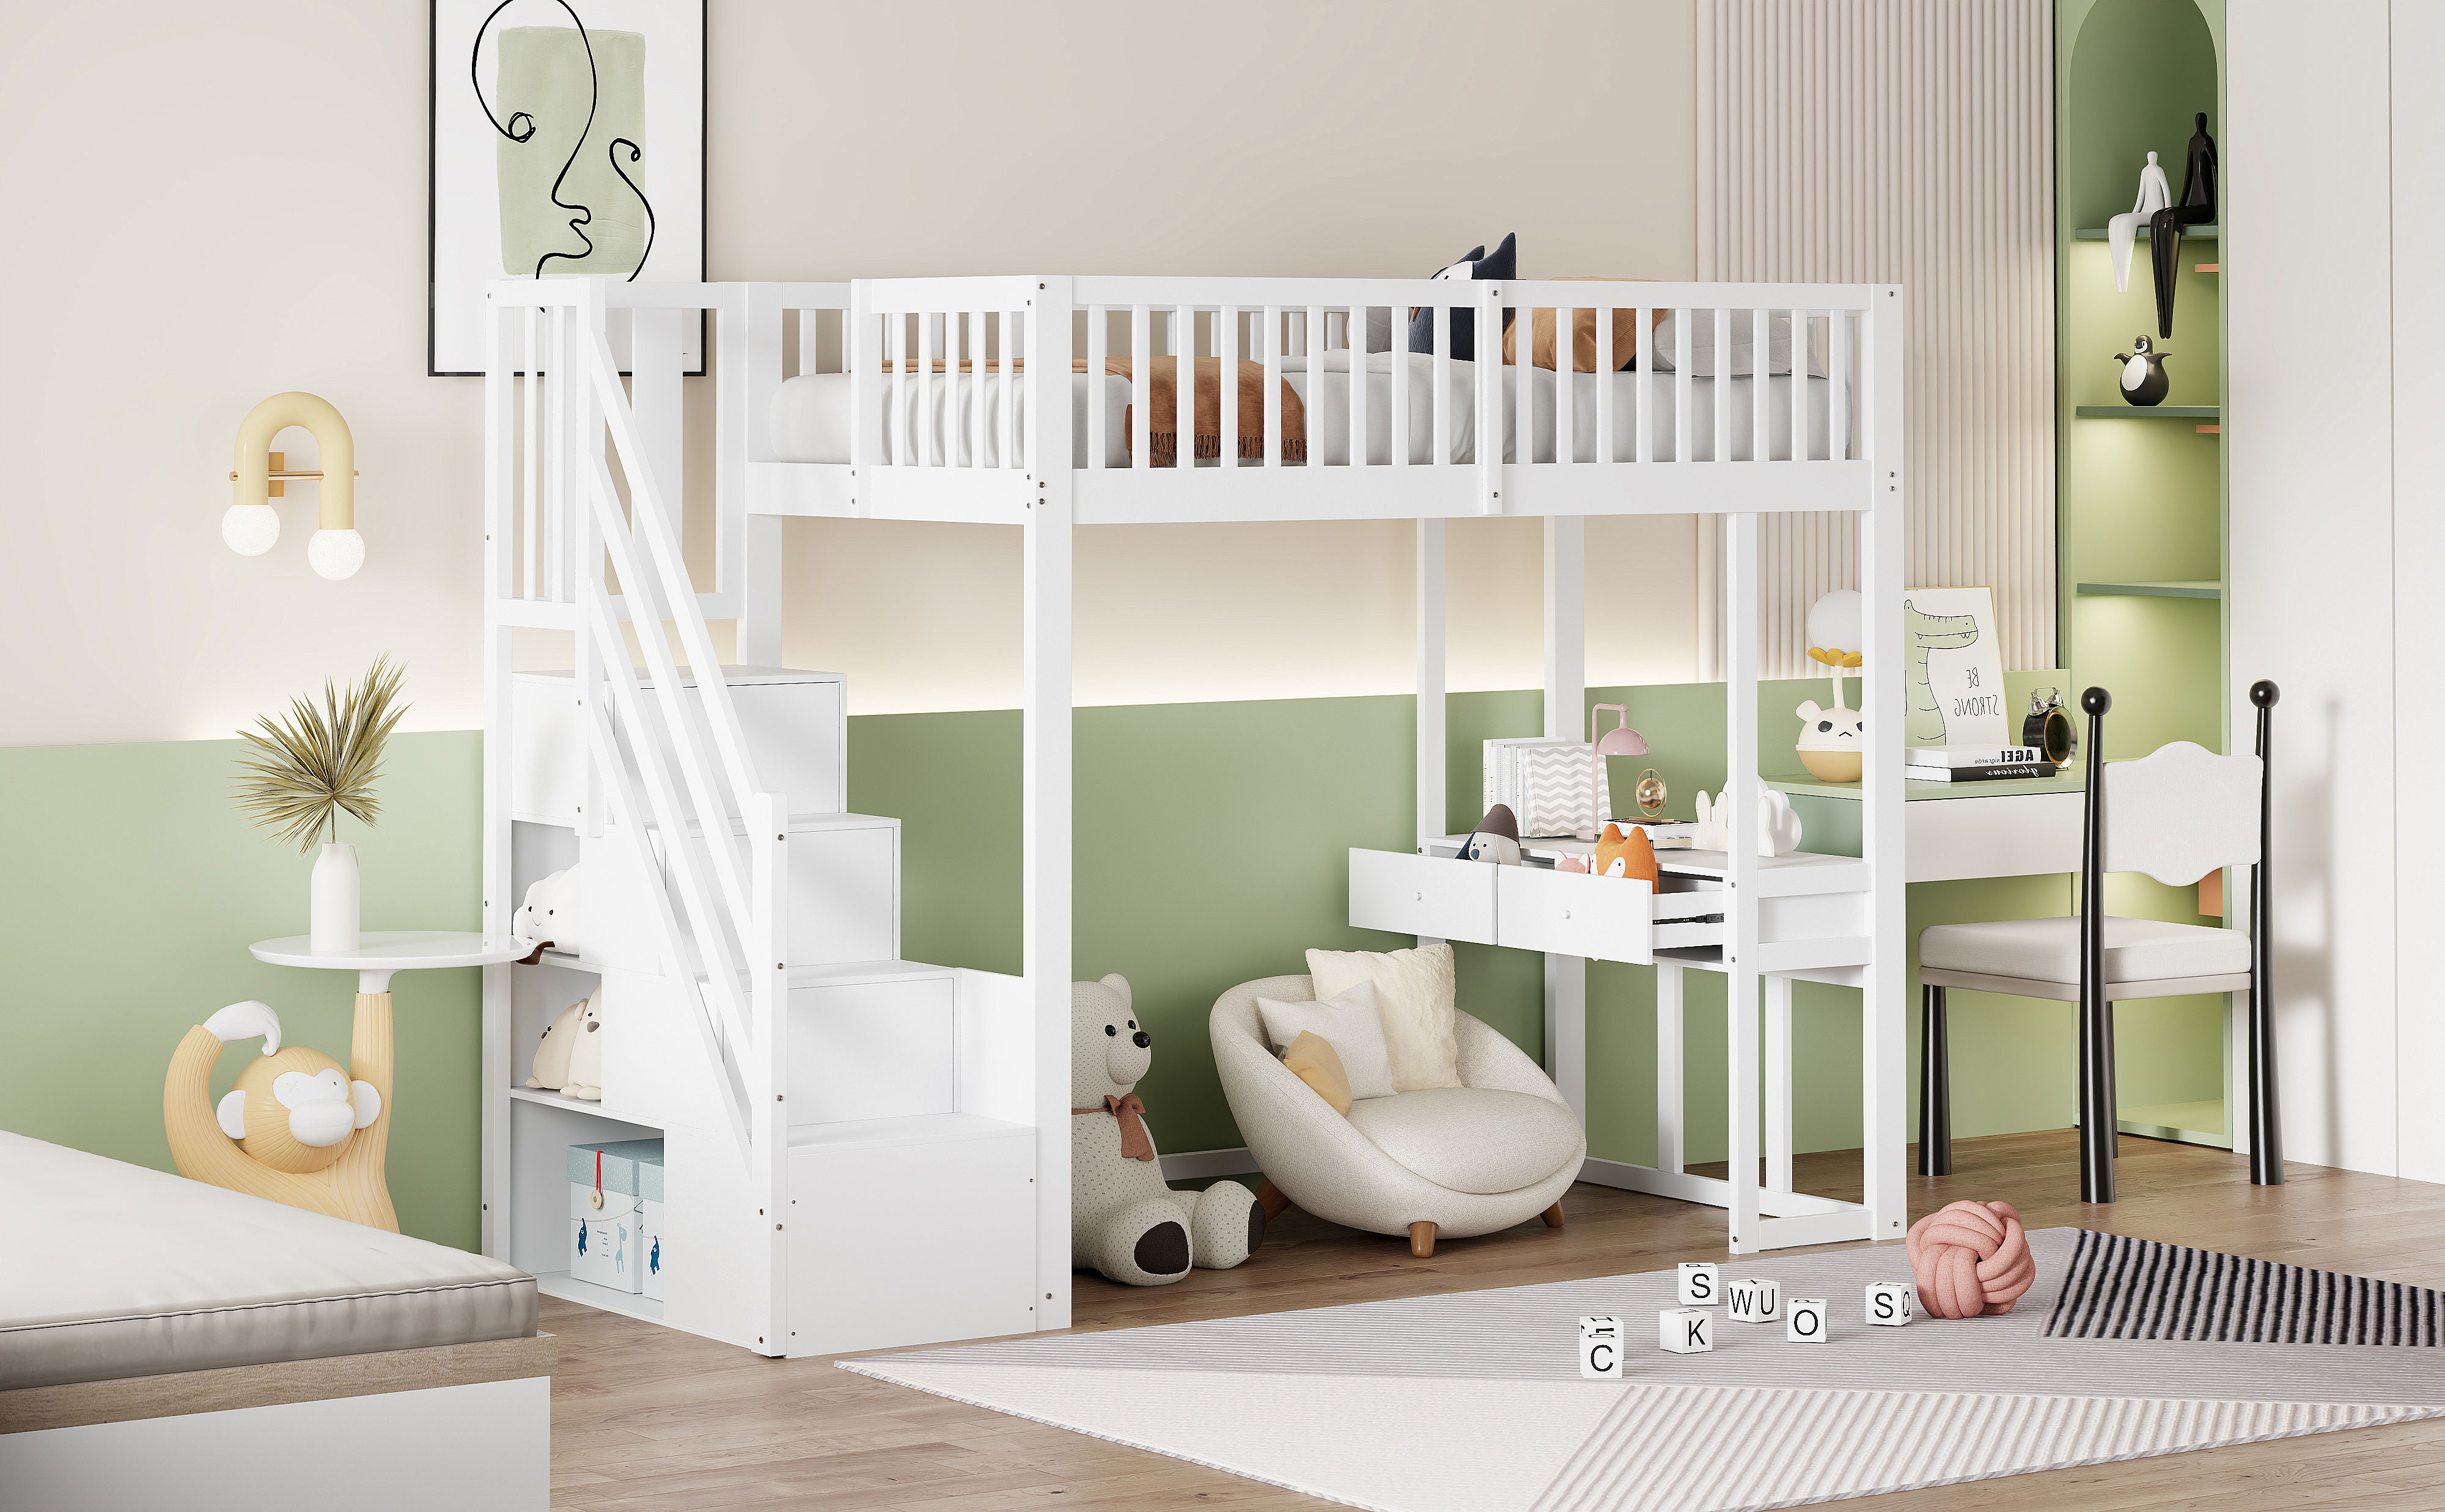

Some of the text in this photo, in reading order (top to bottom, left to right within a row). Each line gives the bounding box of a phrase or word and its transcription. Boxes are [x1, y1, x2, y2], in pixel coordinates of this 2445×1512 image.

[1691, 1273, 1711, 1299] S
[1688, 1318, 1706, 1346] K
[1793, 1309, 1818, 1336] O
[1590, 1344, 1614, 1372] C
